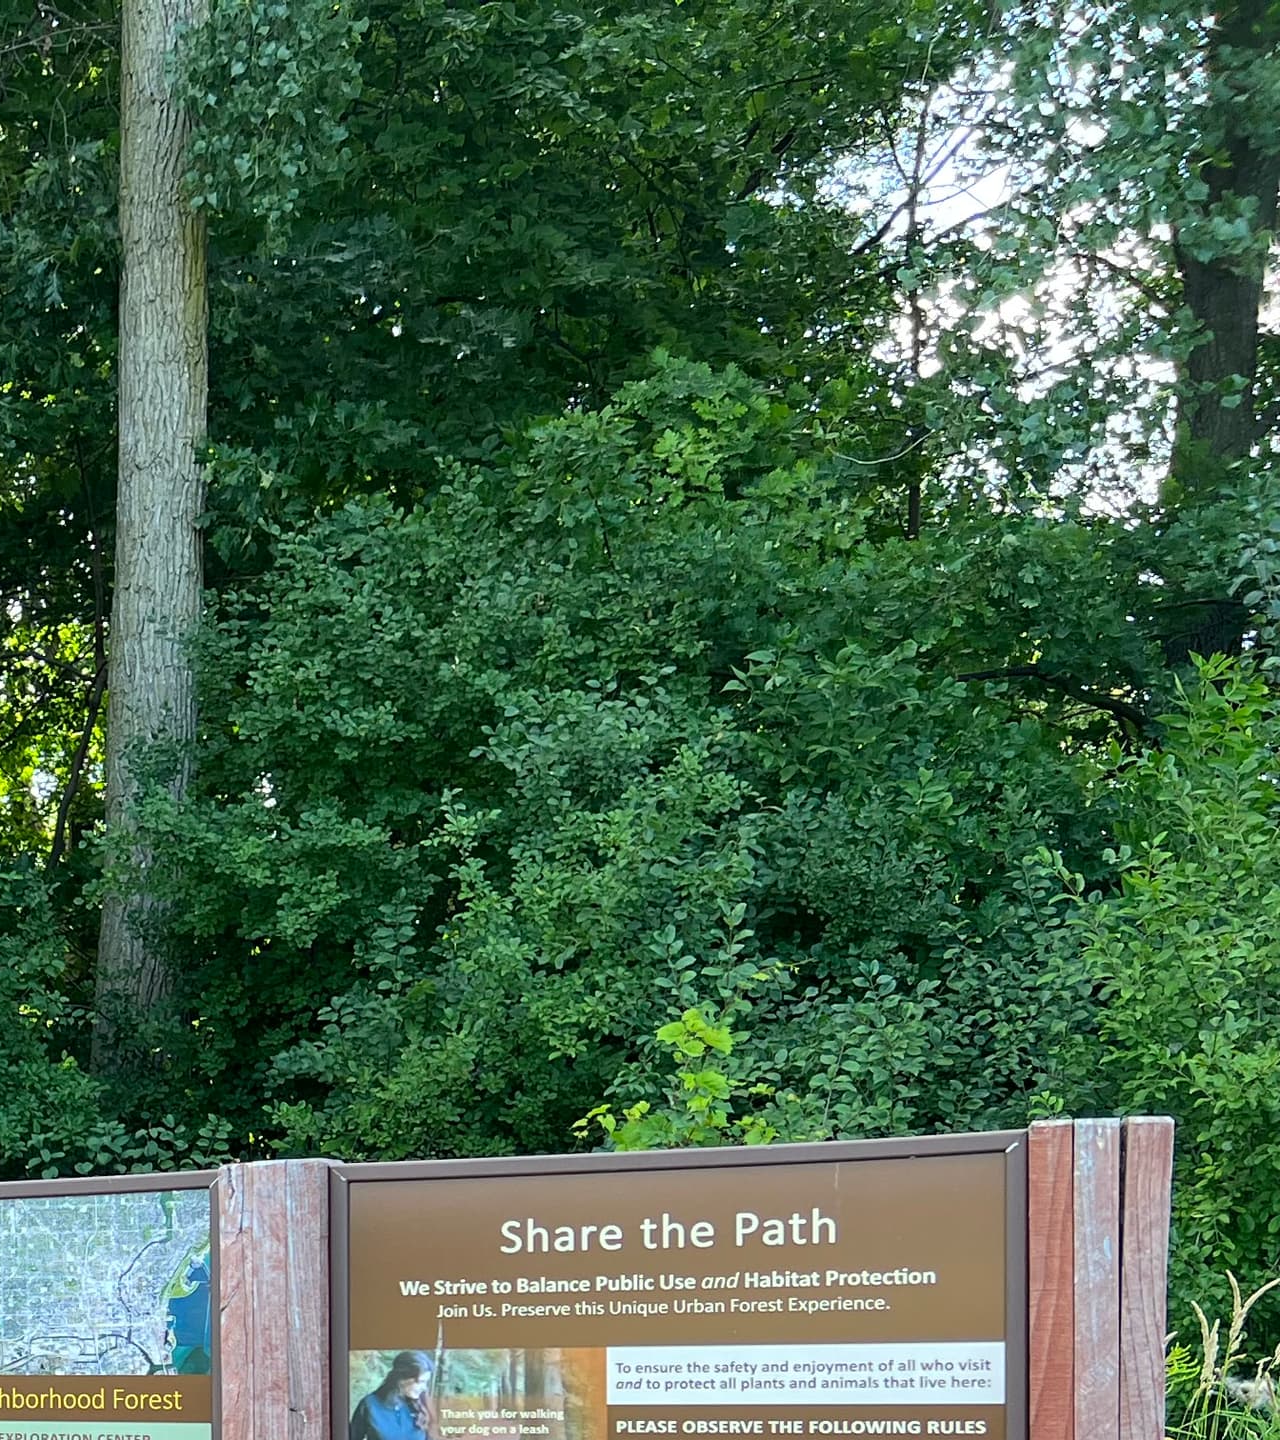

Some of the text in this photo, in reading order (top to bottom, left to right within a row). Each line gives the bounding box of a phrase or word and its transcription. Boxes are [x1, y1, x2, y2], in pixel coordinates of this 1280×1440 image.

[500, 1208, 836, 1254] Share the Path
[400, 1268, 936, 1296] We Strive to Balance Public Use and Habitat Protection
[437, 1297, 891, 1319] Join Us. Preserve this Unique Urban Forest Experience.
[113, 1389, 183, 1410] Forest
[441, 1409, 564, 1421] Thank you for walking
[441, 1426, 465, 1435] your
[469, 1425, 489, 1436] dog
[492, 1426, 507, 1434] on
[519, 1425, 549, 1434] leash
[616, 1421, 986, 1434] PLEASE OBSERVE THE FOLLOWING RULES
